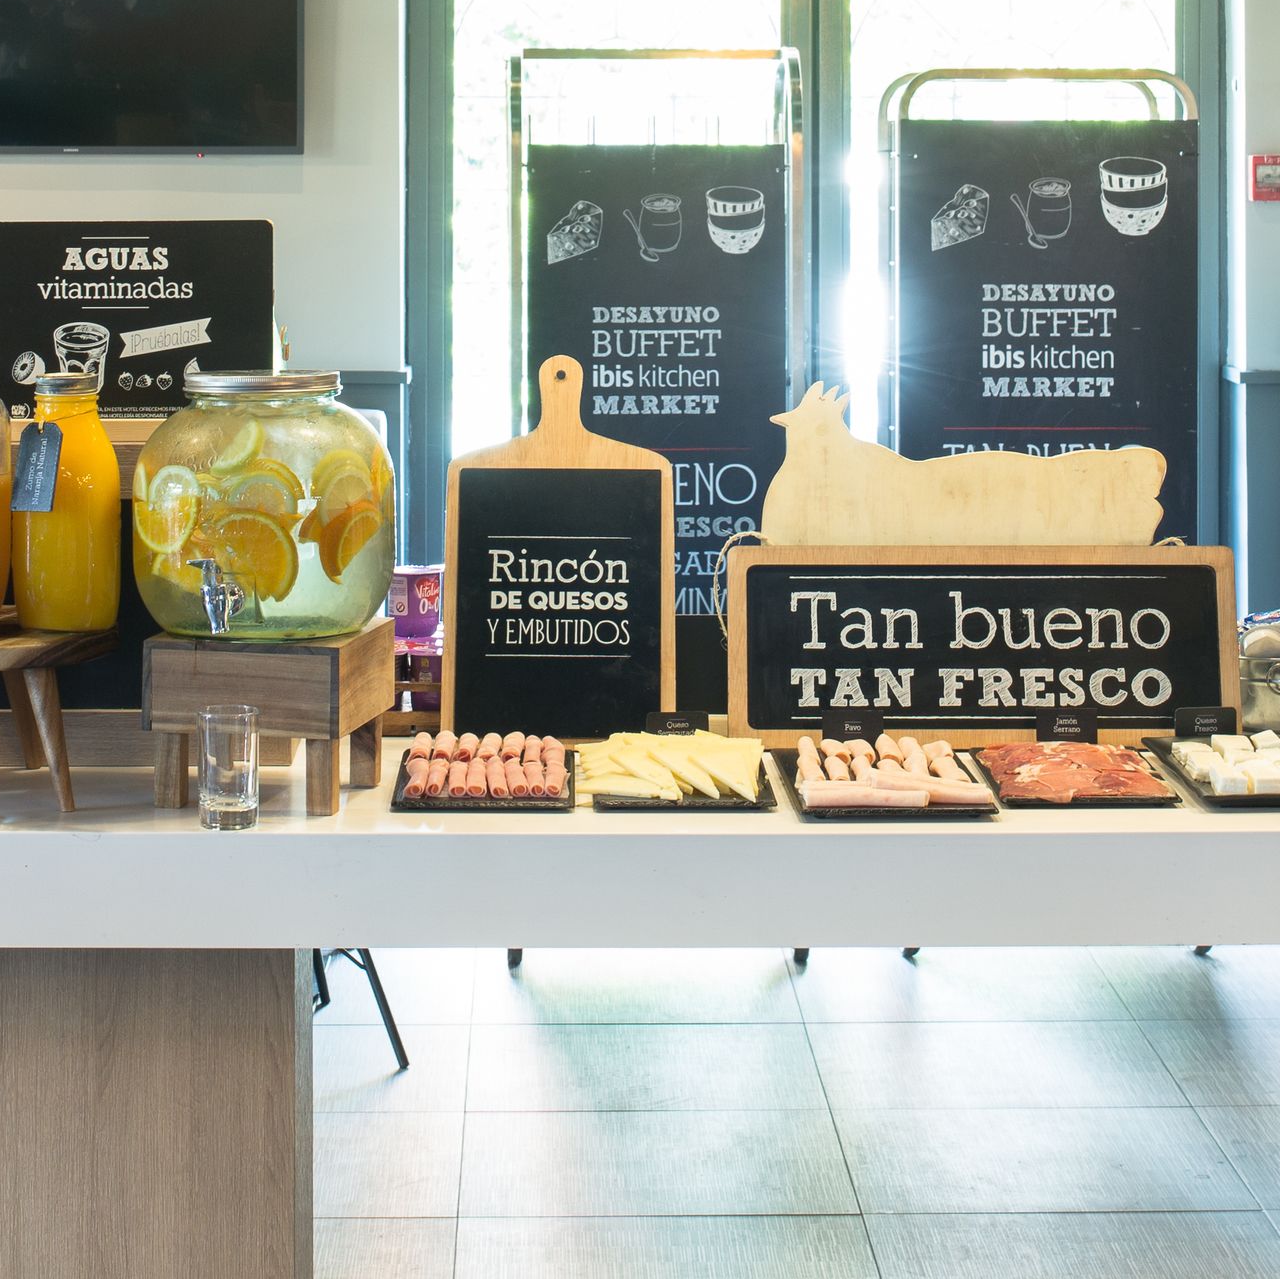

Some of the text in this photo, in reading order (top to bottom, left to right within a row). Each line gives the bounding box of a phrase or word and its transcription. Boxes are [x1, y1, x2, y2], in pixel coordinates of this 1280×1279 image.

[62, 246, 170, 271] AGUAS
[37, 276, 194, 300] vitaminadas
[982, 284, 1116, 302] DESAYUNO
[592, 306, 721, 324] DESAYUNO
[981, 308, 1117, 338] BUFFET
[130, 329, 201, 354] ¡Pruébalas!
[592, 329, 722, 358] BUFFET
[982, 344, 1114, 369] ibis kitchen
[592, 365, 720, 388] ibis kitchen
[982, 377, 1115, 398] MARKET
[592, 395, 720, 415] MARKET
[25, 451, 38, 491] Zumo de
[31, 437, 48, 505] Naranja Natural
[673, 462, 758, 506] ENO
[676, 516, 756, 538] ESCO
[488, 549, 629, 584] Rincón
[490, 590, 628, 612] DE QUESOS
[487, 619, 630, 645] Y EMBUTIDOS
[790, 591, 1171, 651] Tan bueno
[790, 668, 1173, 708] TAN FRESCO
[666, 721, 689, 729] Queso
[844, 723, 862, 731] Pavo
[1053, 725, 1081, 734] Serrano
[1055, 717, 1078, 726] Jamón
[1194, 717, 1217, 725] Queso
[1194, 725, 1218, 733] Fresco
